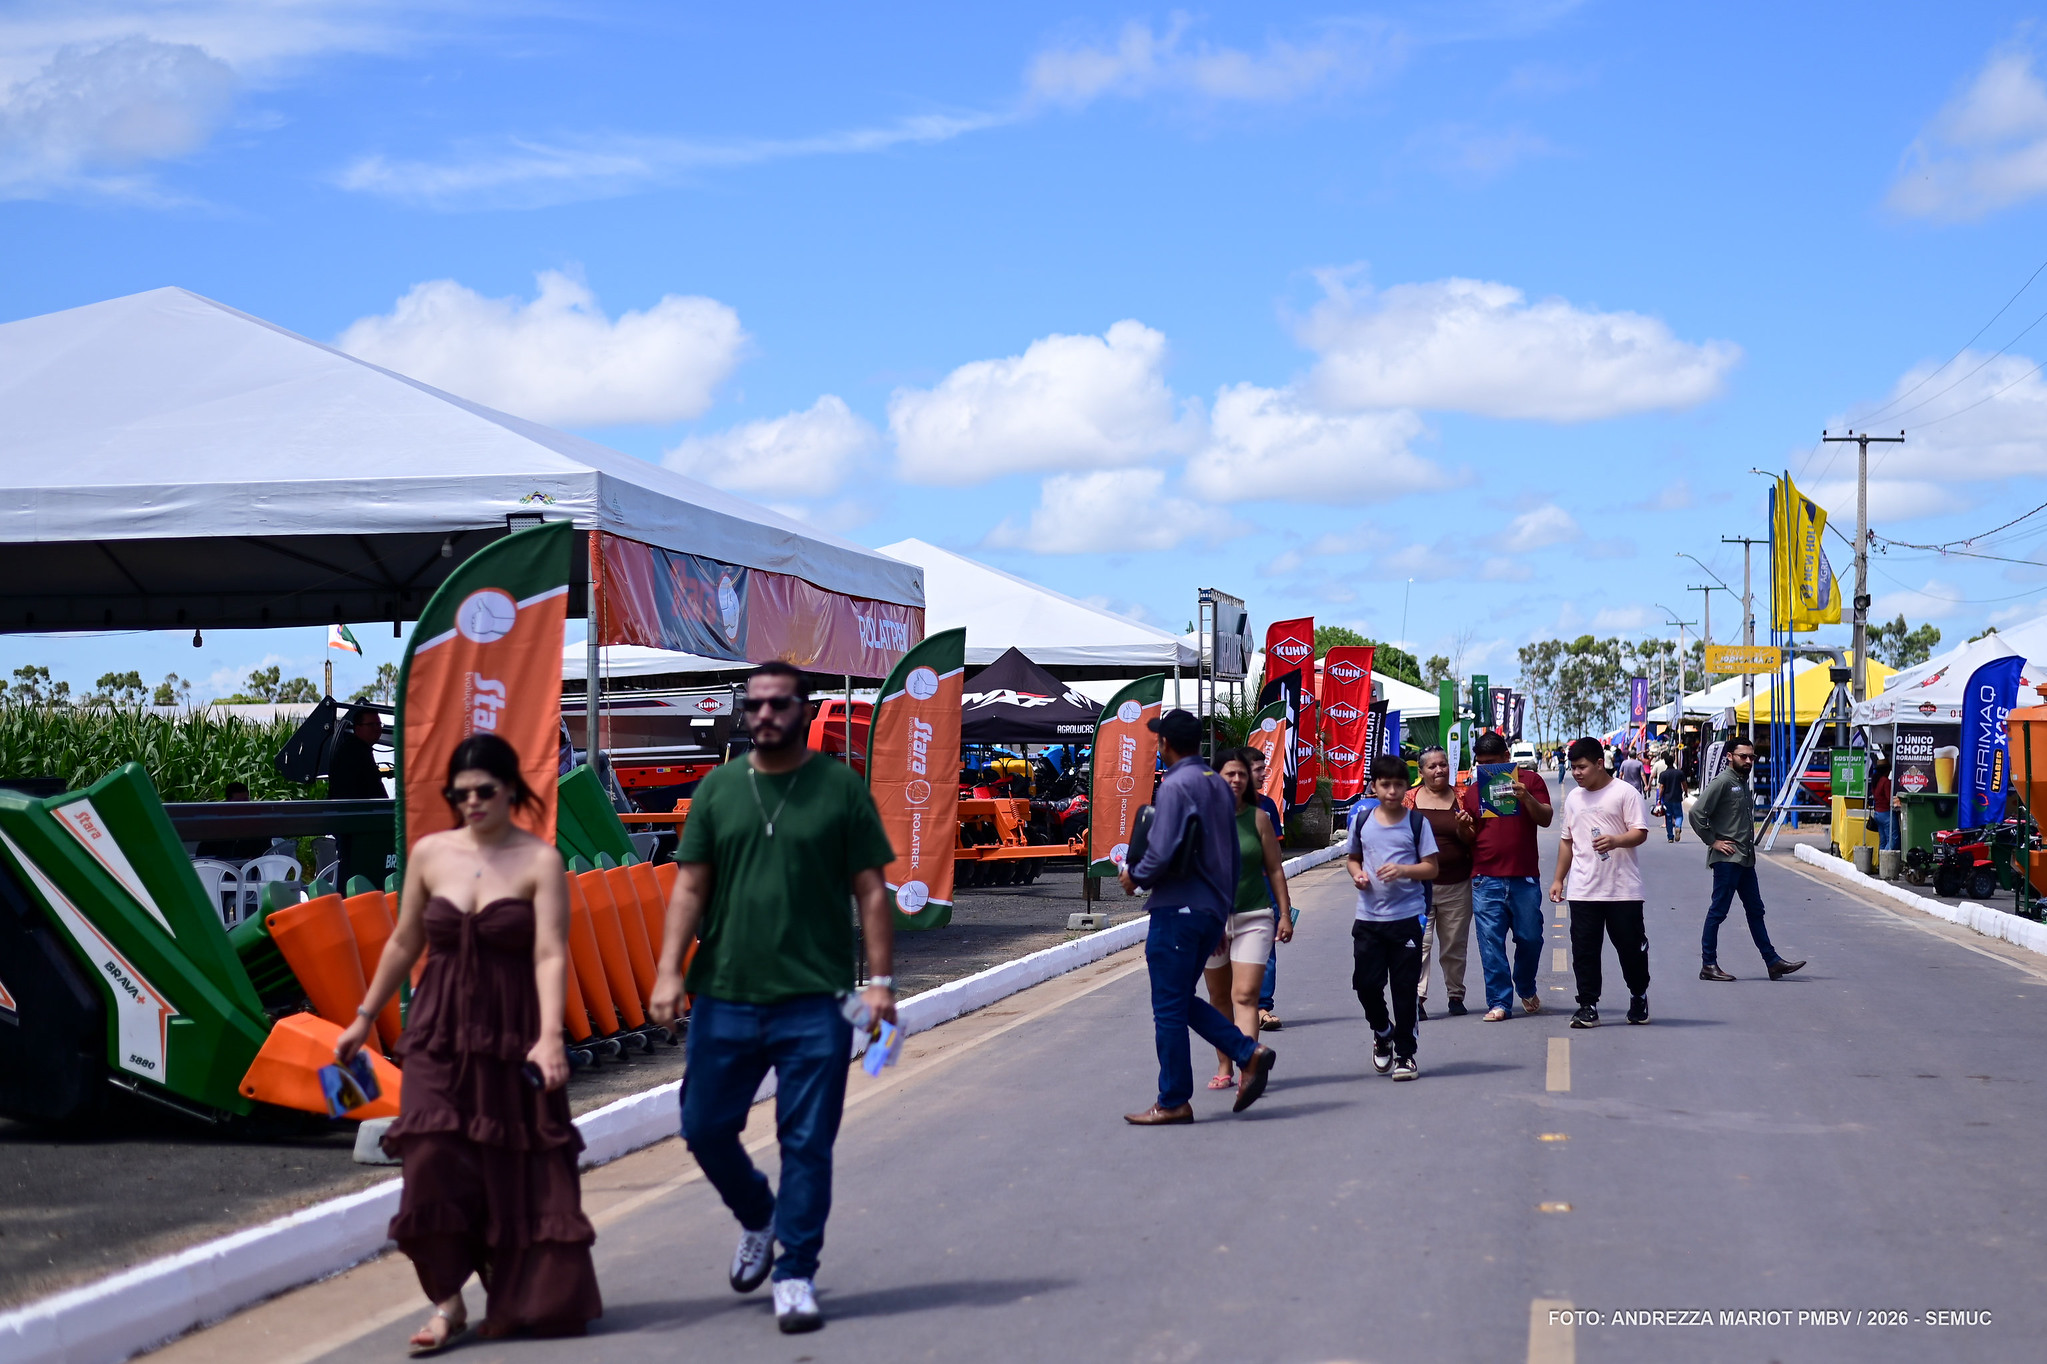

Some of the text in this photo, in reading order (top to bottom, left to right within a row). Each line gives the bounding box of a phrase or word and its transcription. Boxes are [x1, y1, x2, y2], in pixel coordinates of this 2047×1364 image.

[1804, 555, 1814, 582] NEW
[1276, 645, 1309, 657] KUHN
[1331, 666, 1361, 679] KUHN
[473, 671, 506, 736] Sta
[698, 700, 721, 709] KUHN
[1329, 708, 1358, 720] KUHN
[1056, 724, 1095, 734] AGROLUCAS
[1896, 733, 1934, 745] O ÚNICO
[1975, 685, 1997, 791] IRRIMAQ
[912, 717, 933, 776] Stara
[1121, 734, 1138, 774] Stara
[1298, 745, 1313, 757] HN
[1896, 745, 1933, 755] CHOPE
[1327, 751, 1356, 764] KUHN
[1896, 754, 1933, 762] RORAIMENSE
[1992, 751, 2002, 790] TIMBER
[1119, 798, 1127, 836] ROLATREK
[73, 810, 102, 840] Stara
[911, 812, 921, 870] ROLATREK
[129, 1054, 156, 1071] 5880
